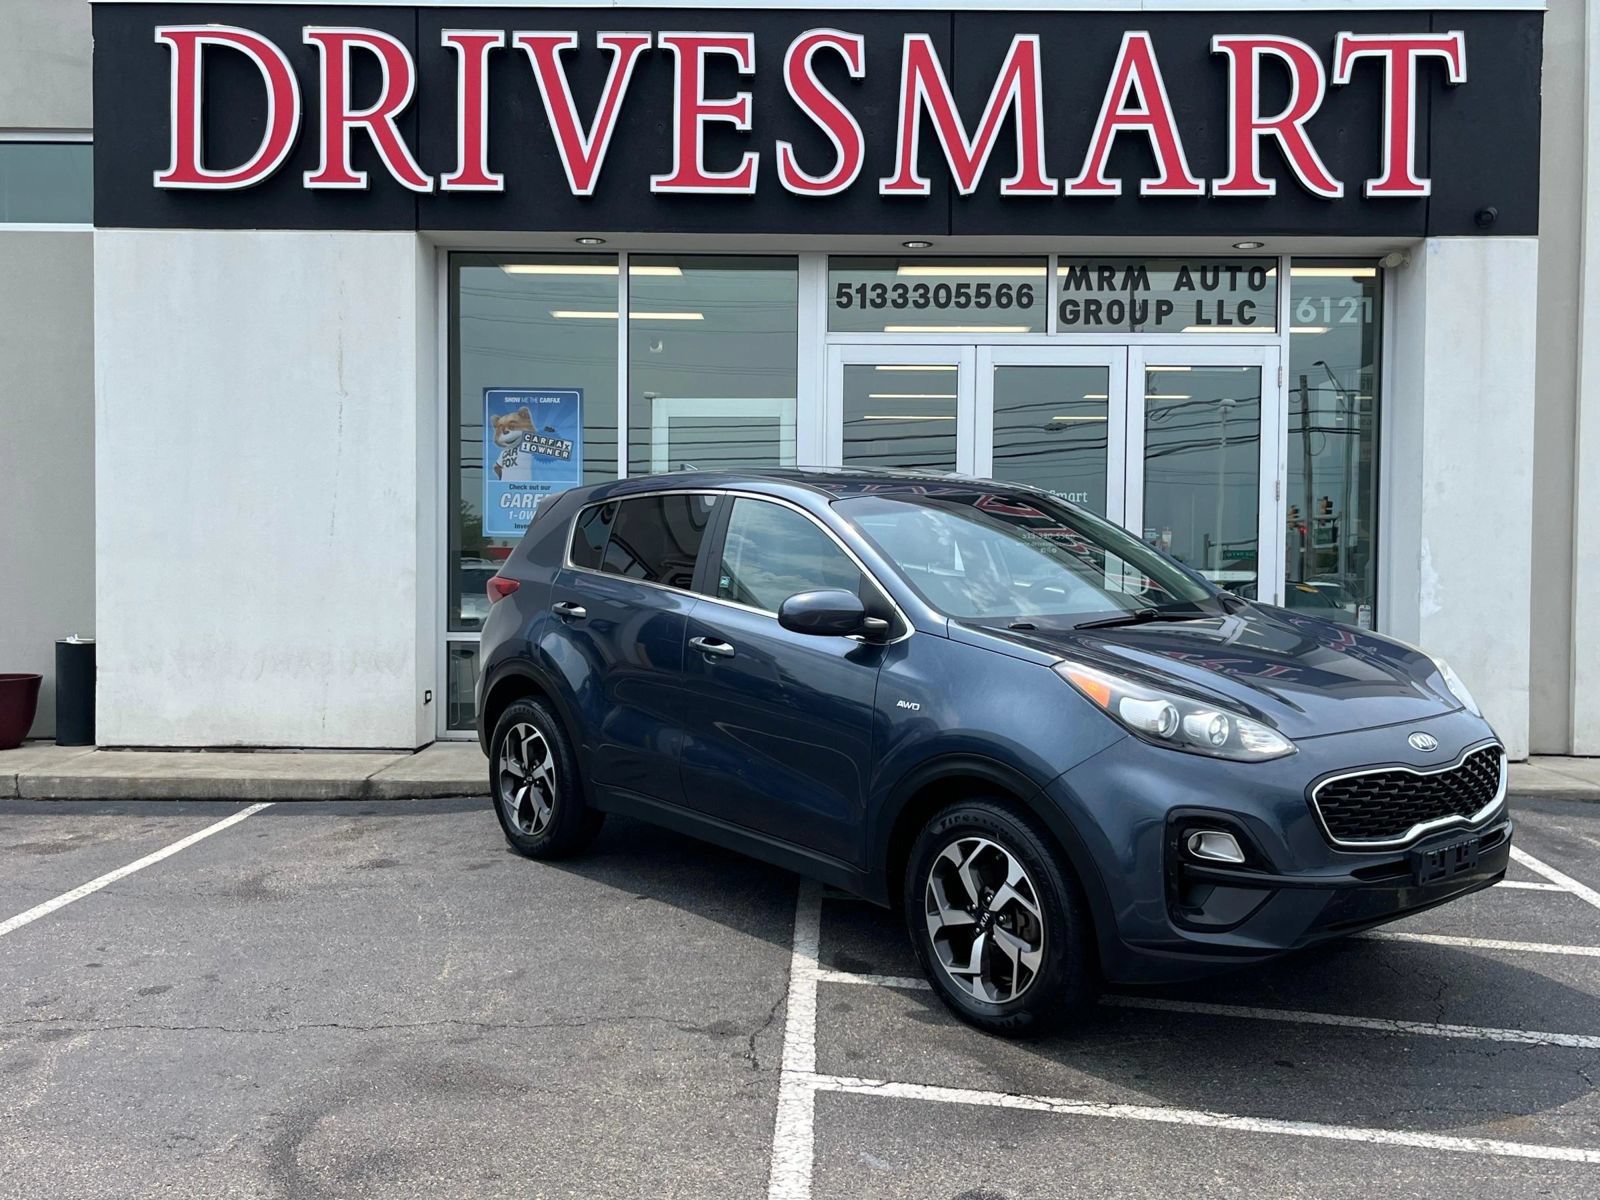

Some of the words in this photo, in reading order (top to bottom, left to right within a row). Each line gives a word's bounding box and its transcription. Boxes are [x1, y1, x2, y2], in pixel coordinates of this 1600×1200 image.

[153, 24, 1468, 197] DRIVESMART
[1063, 265, 1151, 292] MRM
[1173, 265, 1267, 292] AUTO
[836, 283, 1034, 309] 5133305566
[1059, 299, 1174, 325] GROUP
[1195, 299, 1257, 325] LLC
[1296, 296, 1373, 323] 6121
[524, 433, 571, 450] CARFAX
[502, 457, 518, 467] FOX
[500, 493, 550, 508] CARF
[896, 700, 920, 711] AWD
[1411, 734, 1437, 749] KIA
